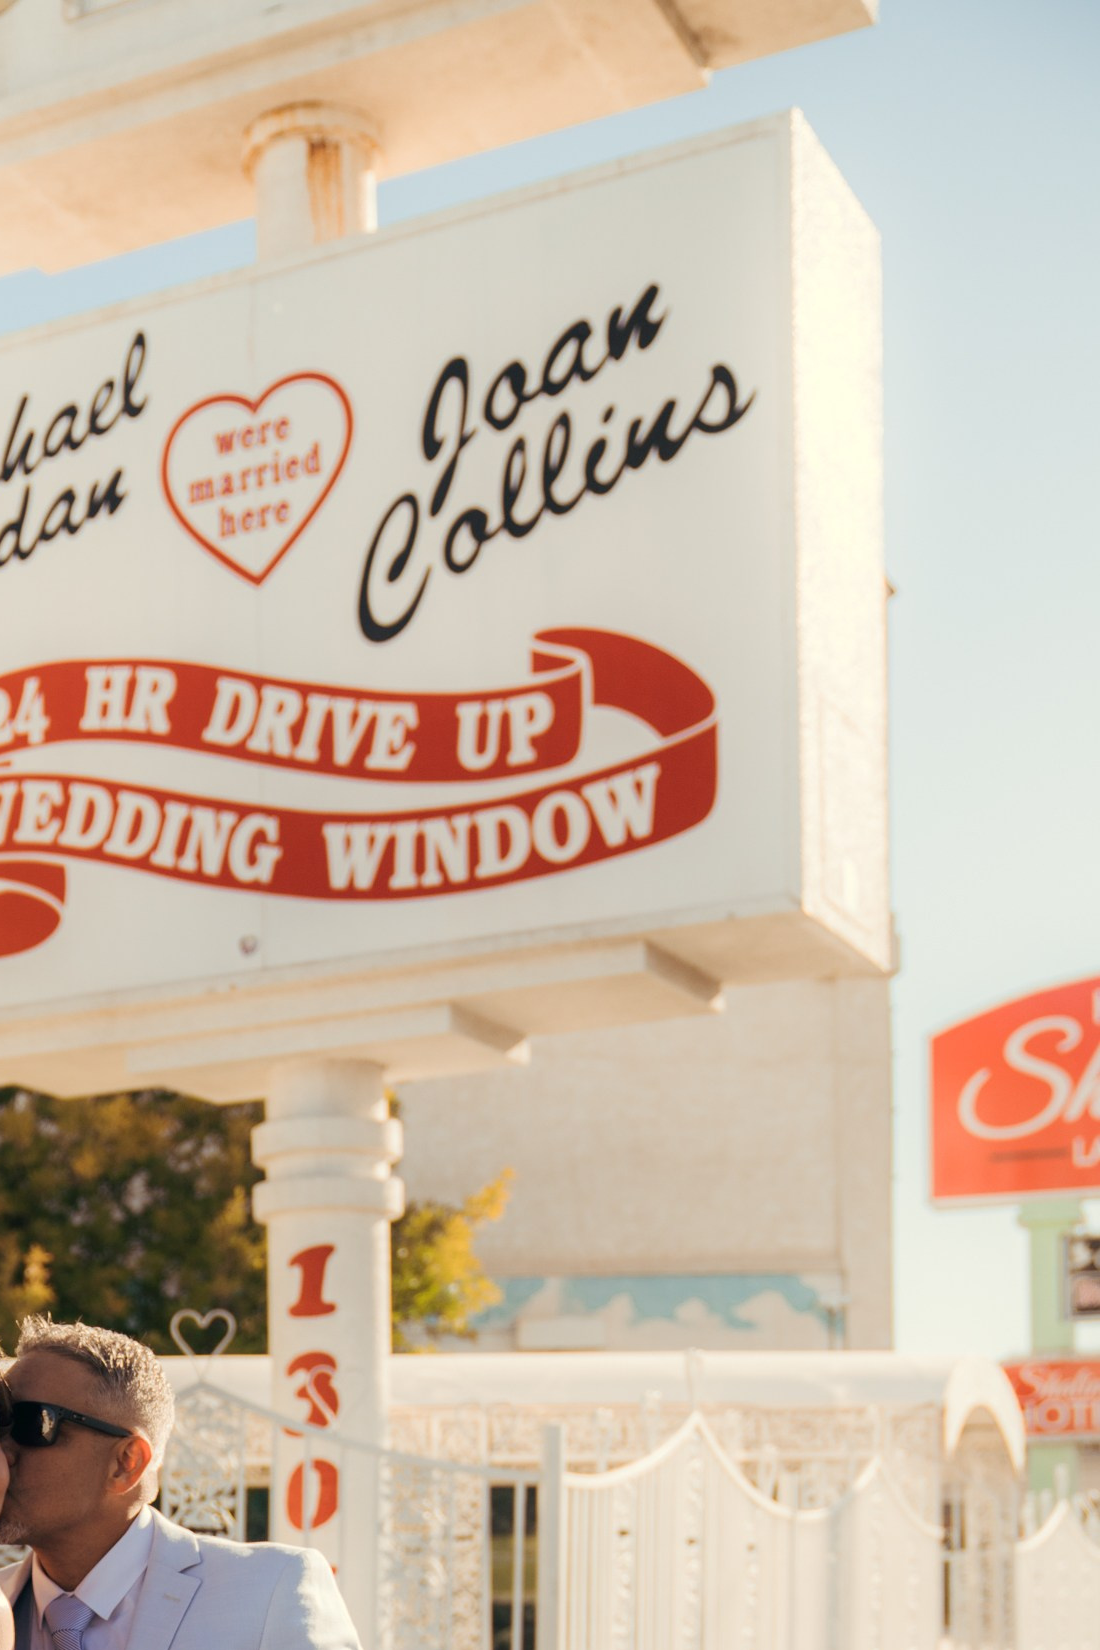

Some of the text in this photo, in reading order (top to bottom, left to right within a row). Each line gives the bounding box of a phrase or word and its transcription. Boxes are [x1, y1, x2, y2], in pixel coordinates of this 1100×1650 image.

[214, 416, 290, 456] were
[422, 283, 669, 518] Joan
[187, 440, 322, 504] married
[217, 499, 290, 539] here
[357, 363, 757, 643] Collins
[79, 664, 177, 736] HR
[201, 675, 420, 772] DRIVE
[455, 690, 555, 772] UP
[322, 761, 662, 892] WINDOW
[284, 1243, 339, 1578] 130
